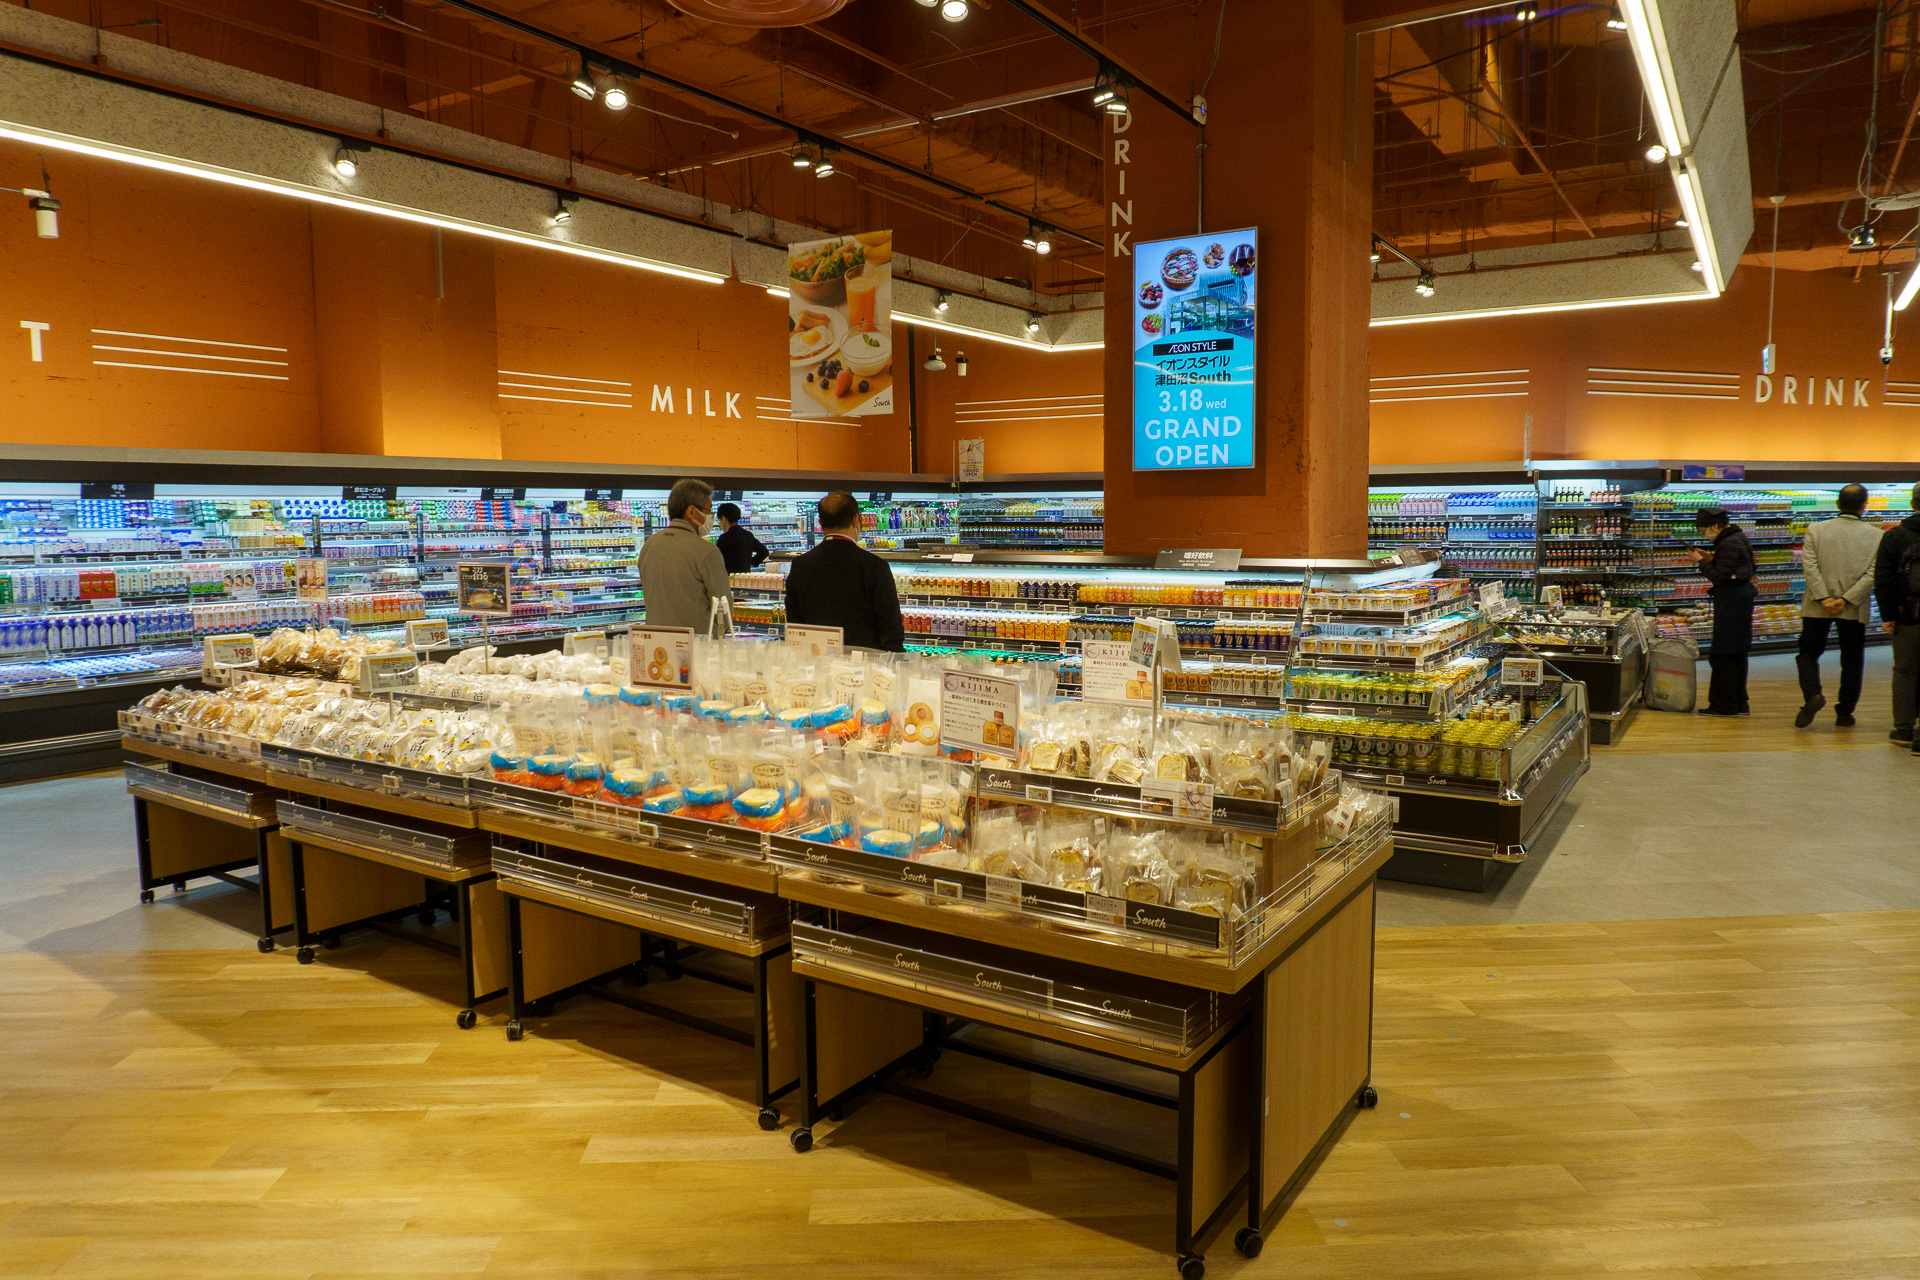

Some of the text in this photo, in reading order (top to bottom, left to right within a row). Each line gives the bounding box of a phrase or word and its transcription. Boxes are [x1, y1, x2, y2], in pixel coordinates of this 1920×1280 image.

[1112, 109, 1132, 257] DRINK
[20, 320, 50, 362] T
[1192, 341, 1217, 351] STYLE
[1156, 355, 1230, 371] イオンスタイル
[1155, 370, 1231, 387] 津田沼South
[1755, 374, 1870, 406] DRINK
[651, 384, 742, 419] MILK
[873, 397, 891, 408] South
[1158, 389, 1227, 412] 3.18 wed
[1145, 416, 1241, 440] GRAND
[1155, 444, 1229, 466] OPEN
[430, 631, 446, 640] 198
[234, 648, 252, 658] 198
[1520, 670, 1536, 678] 138
[960, 682, 999, 694] KIJIMA
[986, 774, 1012, 789] South
[1090, 787, 1120, 804] South
[706, 828, 726, 844] South
[804, 847, 829, 864] South
[576, 873, 593, 887] South
[901, 866, 928, 884] South
[630, 886, 648, 901] South
[690, 901, 711, 915] South
[1133, 908, 1167, 929] South
[828, 938, 853, 955] South
[893, 953, 920, 971] South
[973, 972, 1003, 991] South
[1099, 1000, 1132, 1020] South
